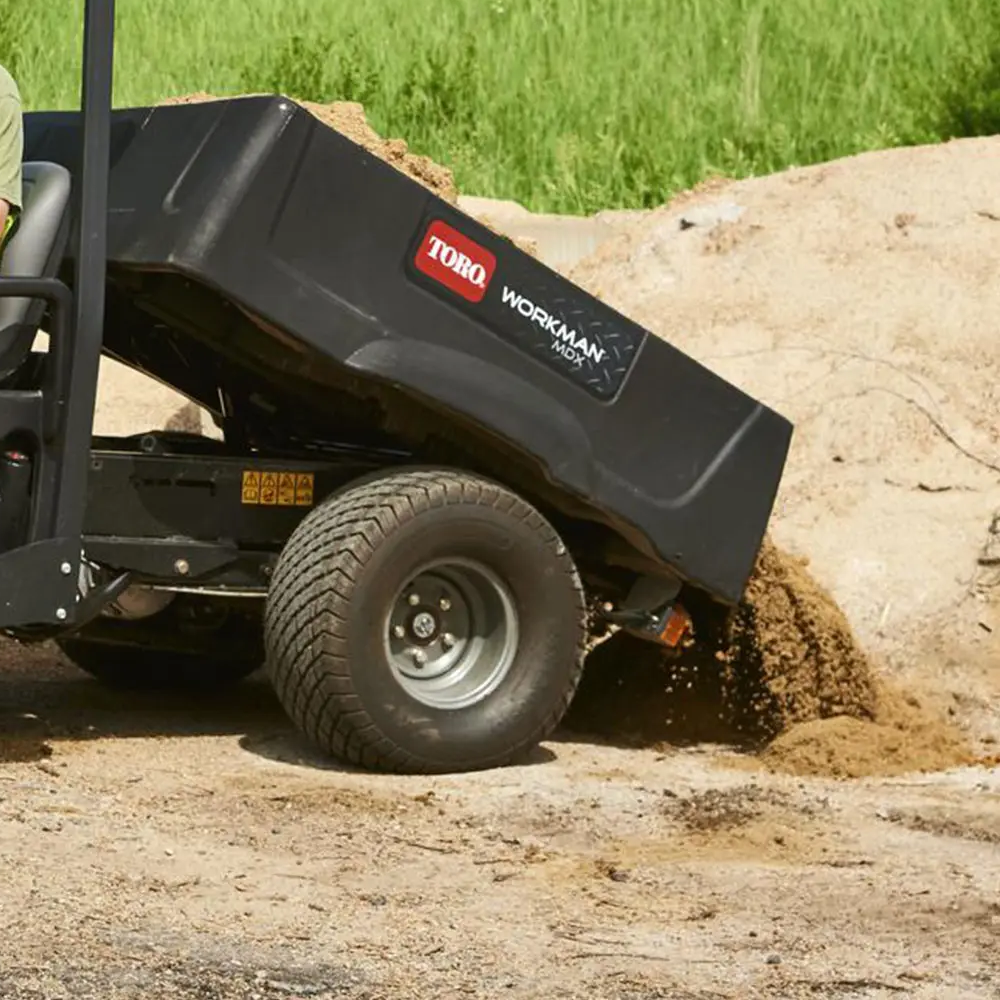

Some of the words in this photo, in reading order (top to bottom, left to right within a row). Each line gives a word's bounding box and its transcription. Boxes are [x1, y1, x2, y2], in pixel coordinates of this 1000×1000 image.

[427, 235, 486, 286] TORO
[501, 286, 606, 363] WORKMAN
[551, 340, 586, 367] MDX
